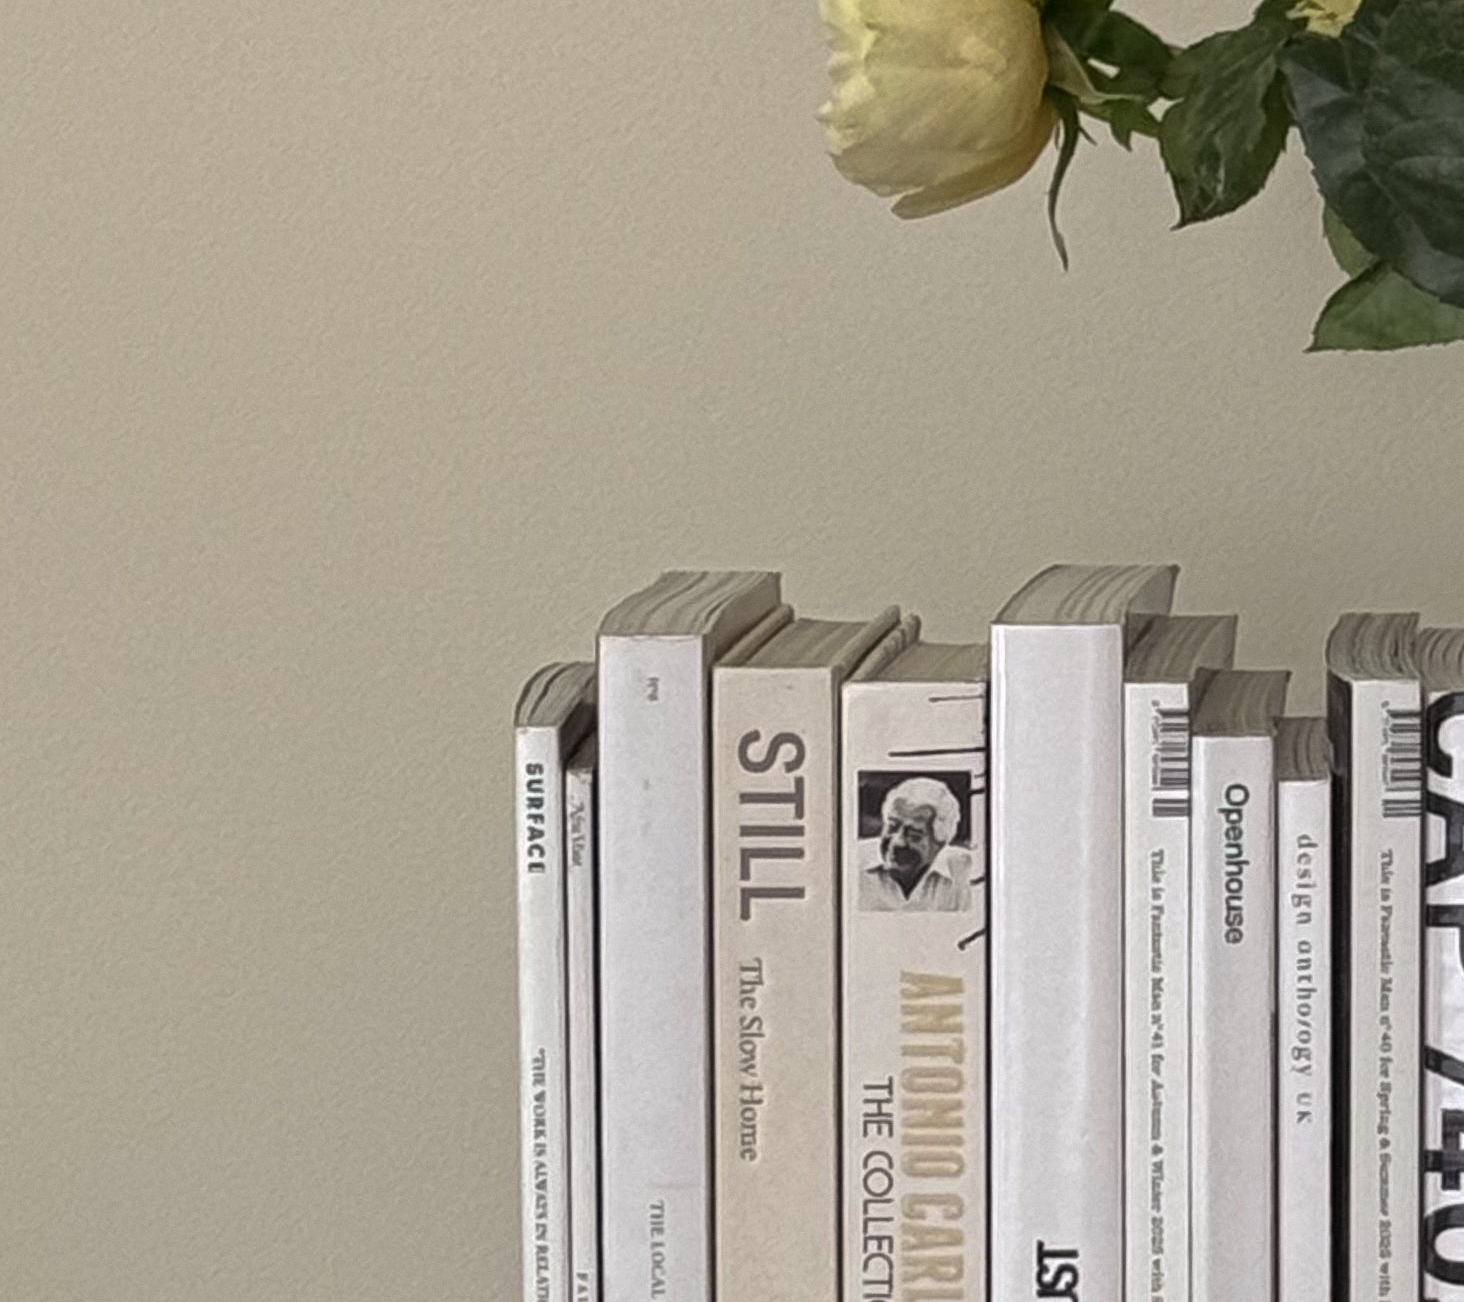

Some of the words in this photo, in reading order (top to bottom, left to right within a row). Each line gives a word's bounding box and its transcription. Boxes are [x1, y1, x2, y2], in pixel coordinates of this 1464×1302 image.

[526, 763, 545, 874] SURFACE
[738, 729, 805, 922] STILL
[1218, 783, 1249, 944] Openhouse
[1291, 834, 1318, 926] design
[739, 958, 764, 1010] The
[739, 1015, 765, 1077] Slow
[900, 970, 965, 1179] ANTONIO
[1152, 1054, 1164, 1076] for
[532, 1090, 547, 1139] WORK
[739, 1083, 763, 1161] Home
[863, 1076, 893, 1137] THE
[533, 1160, 548, 1220] ALWAYS
[650, 1200, 664, 1237] THE
[651, 1241, 666, 1299] LOCAL
[1151, 1258, 1164, 1292] with
